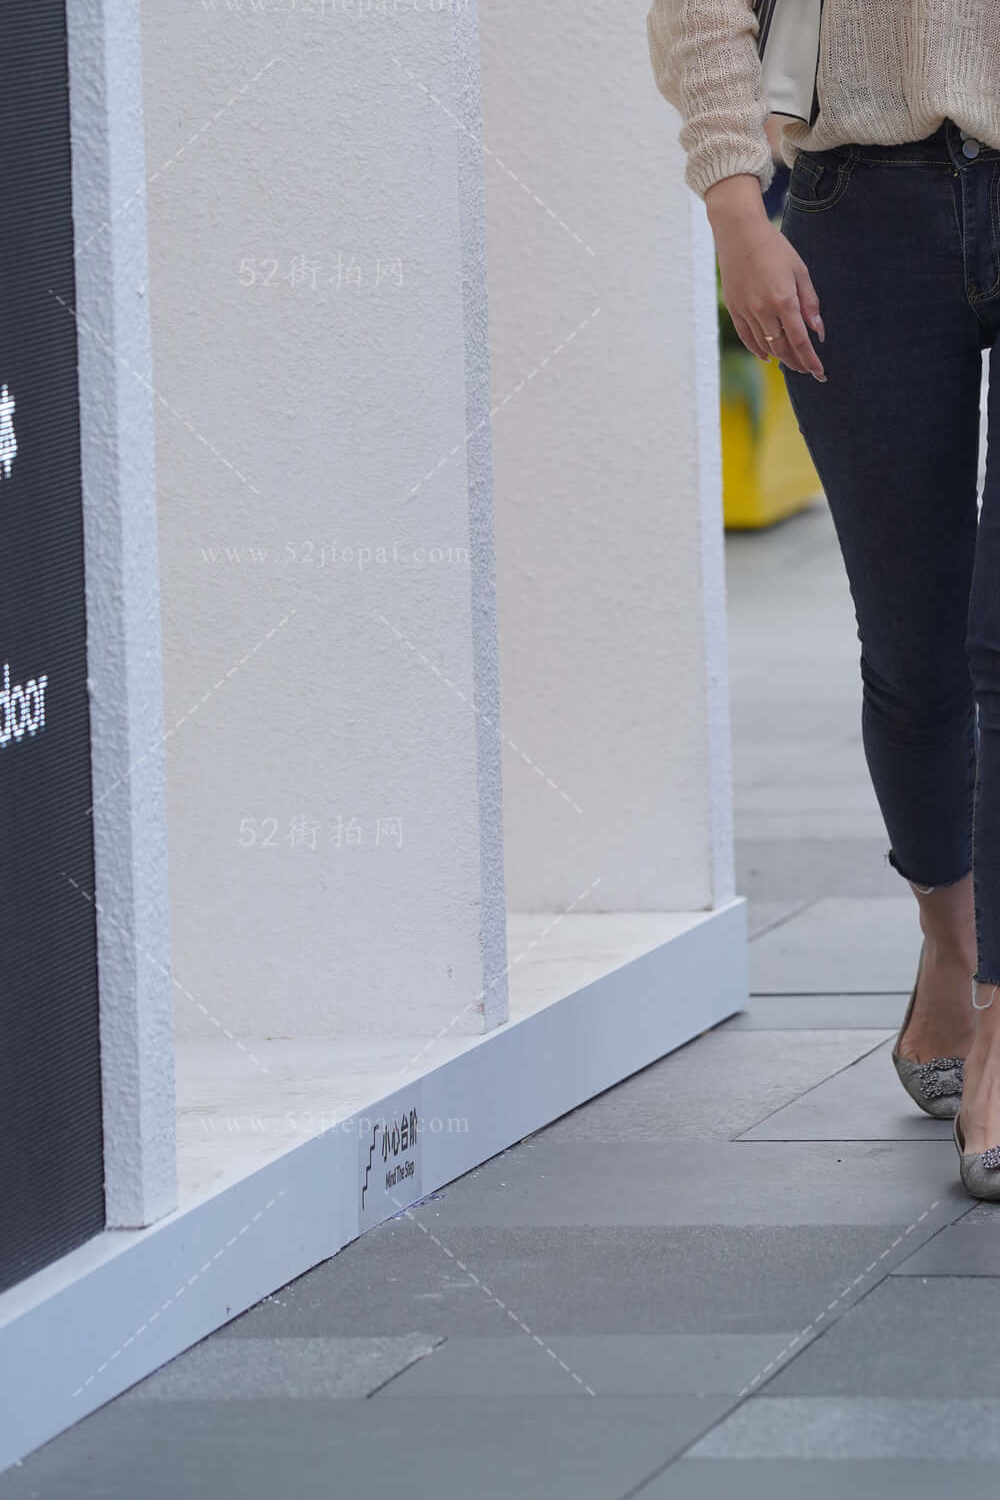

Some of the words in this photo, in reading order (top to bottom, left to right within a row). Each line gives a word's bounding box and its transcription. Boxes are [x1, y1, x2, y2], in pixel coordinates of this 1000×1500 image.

[382, 1107, 418, 1162] 小心台阶
[385, 1169, 396, 1189] Mind
[405, 1160, 415, 1179] Step
